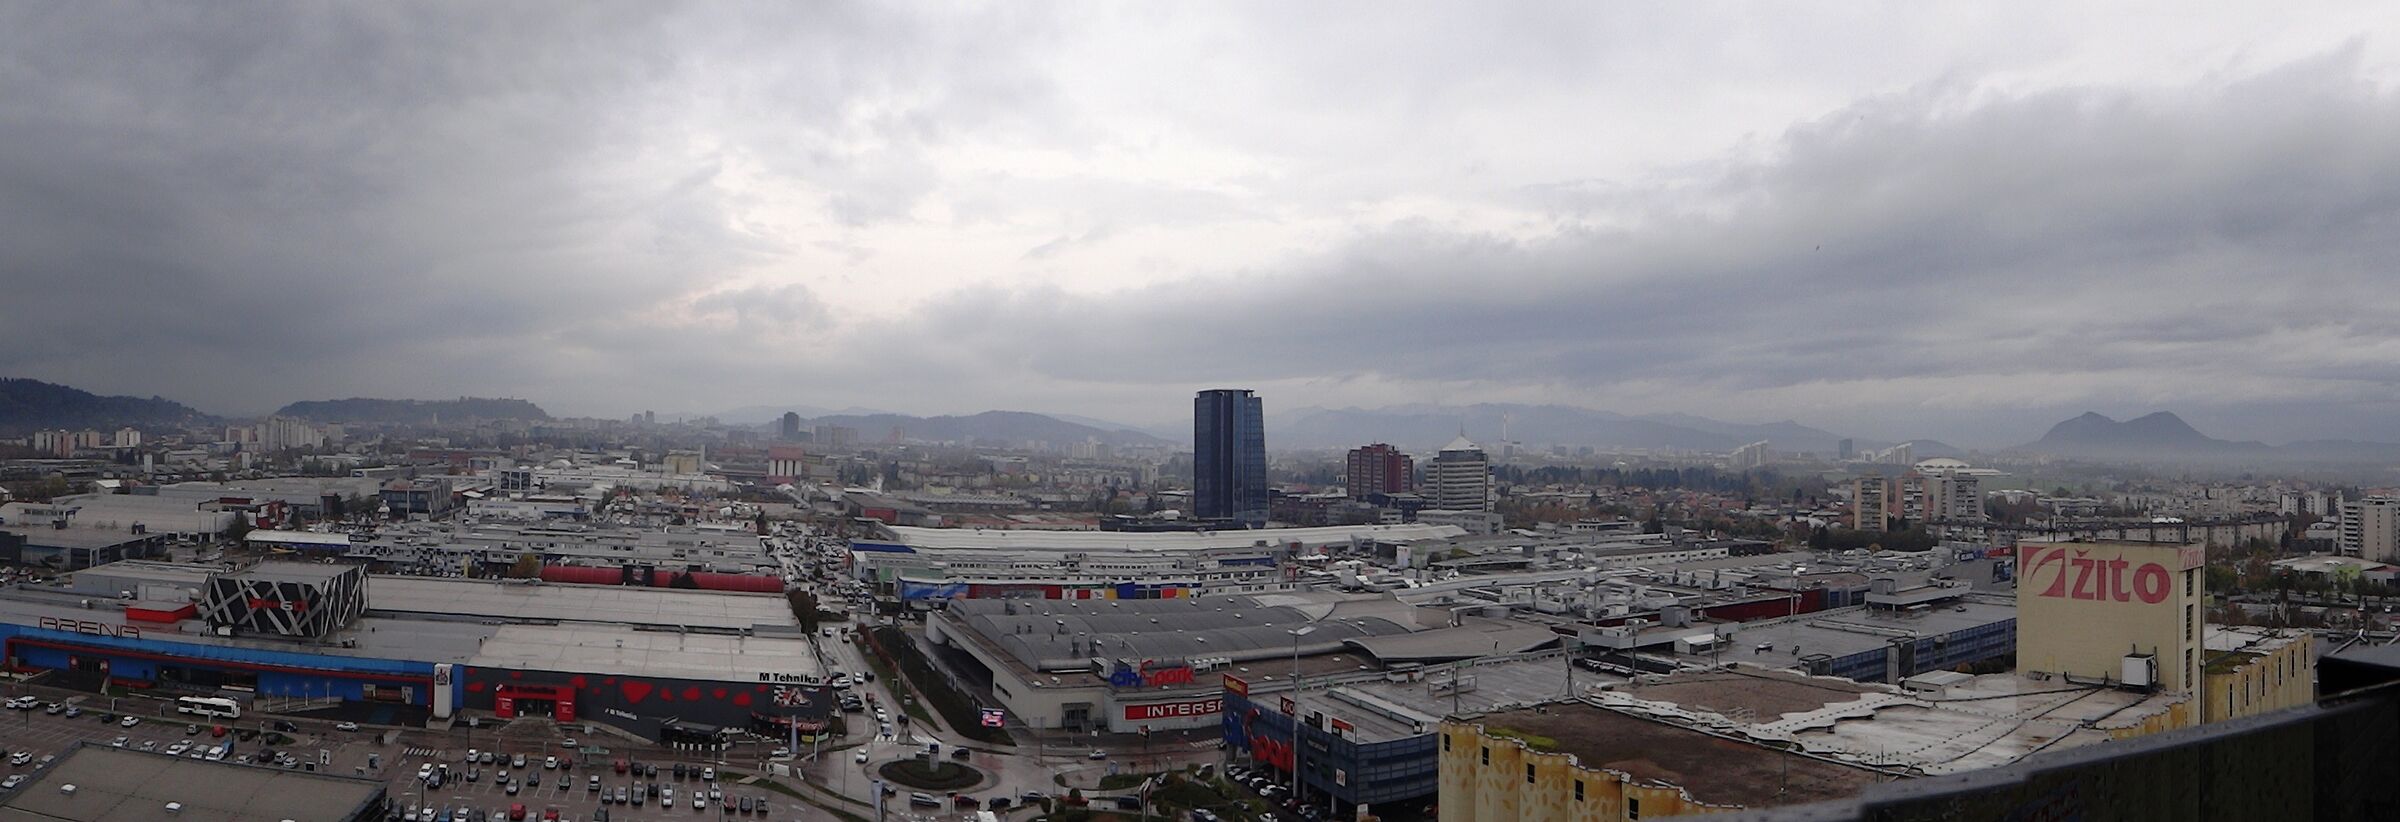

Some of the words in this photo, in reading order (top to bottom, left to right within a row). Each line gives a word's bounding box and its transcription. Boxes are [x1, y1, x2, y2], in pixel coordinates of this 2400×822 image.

[40, 616, 140, 639] ARENA
[759, 672, 770, 682] M
[773, 673, 819, 684] Tehnika
